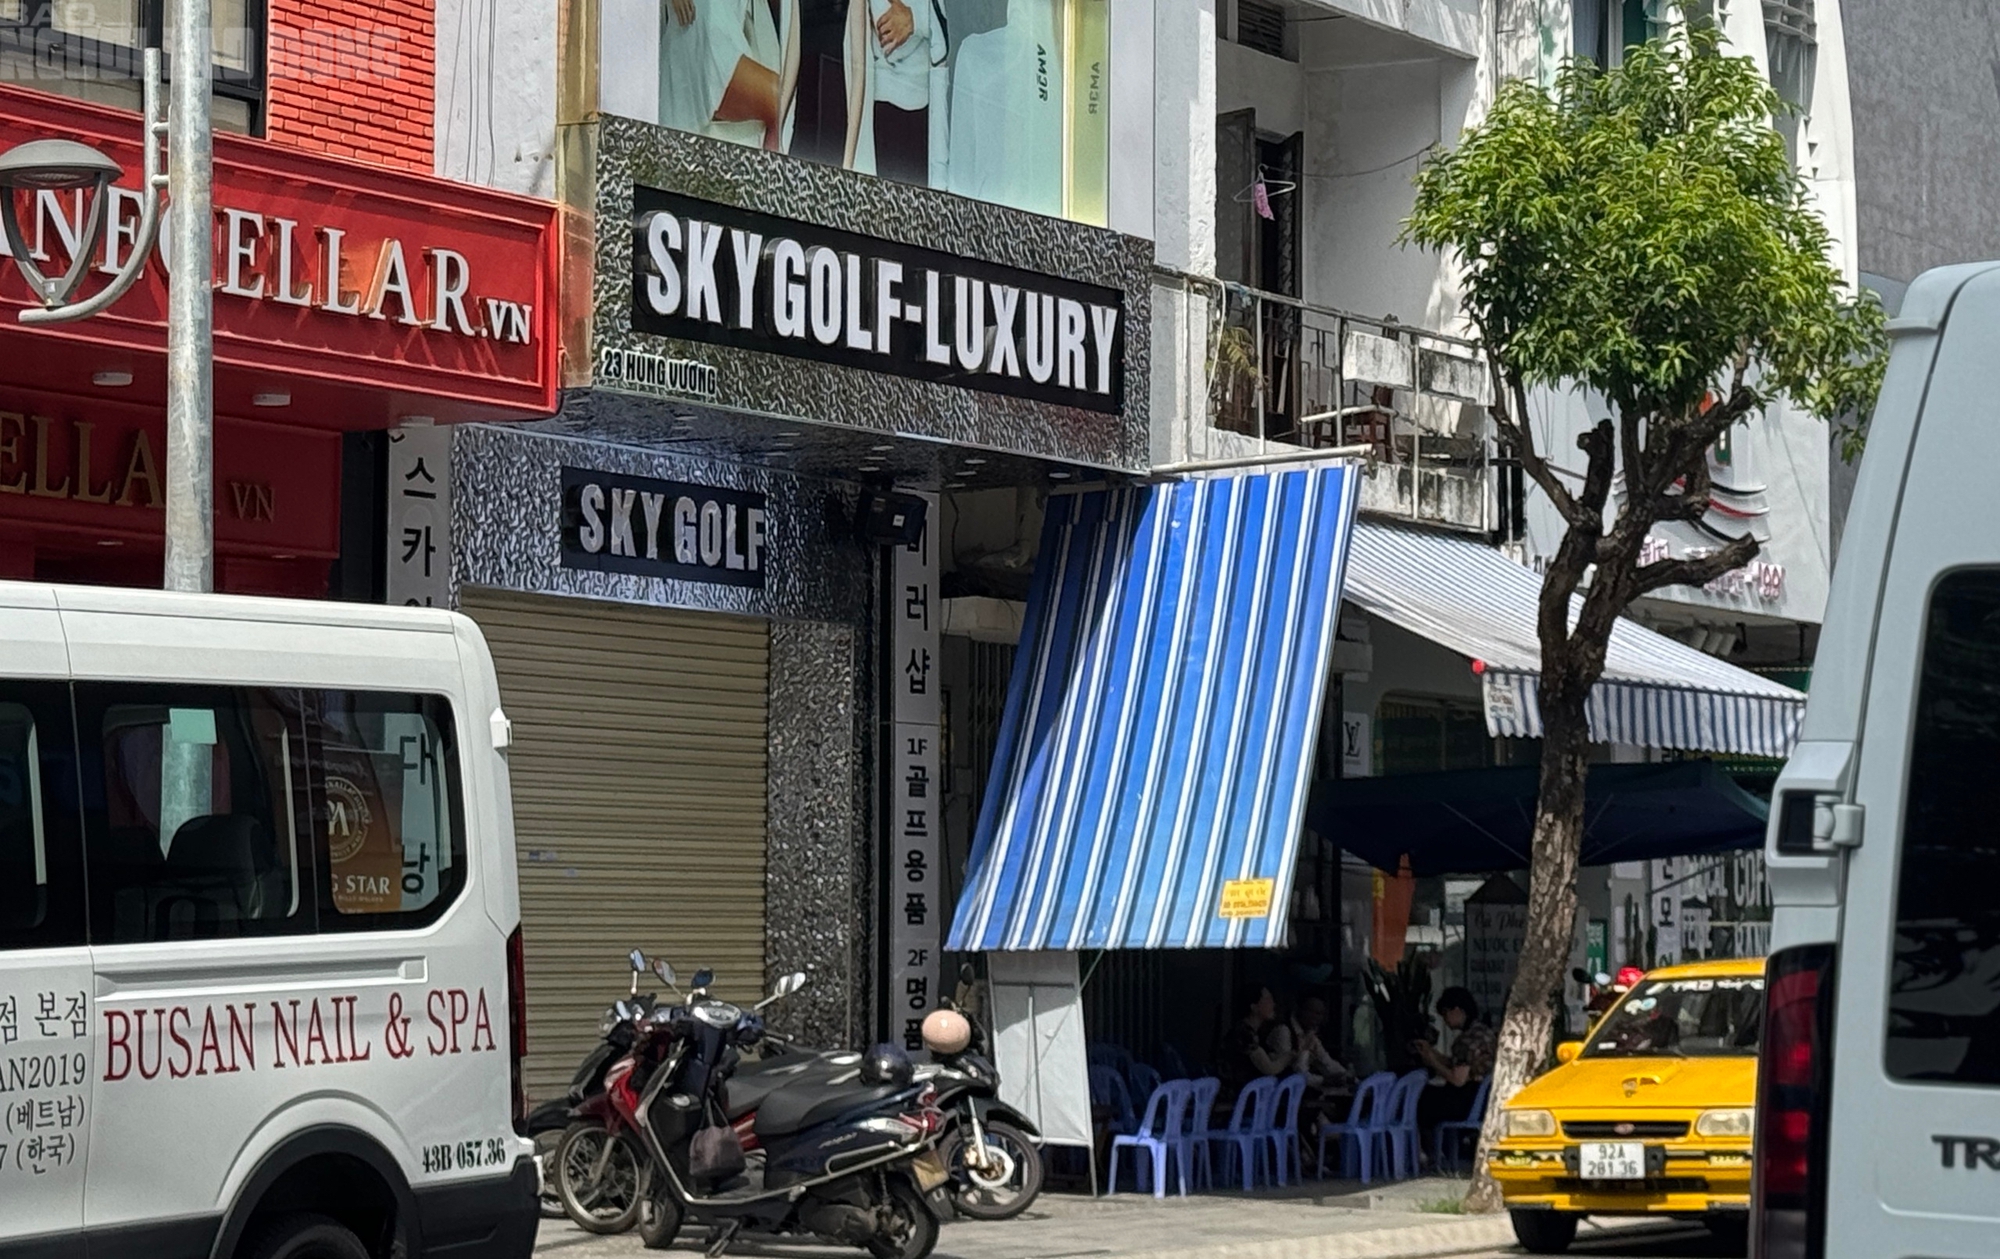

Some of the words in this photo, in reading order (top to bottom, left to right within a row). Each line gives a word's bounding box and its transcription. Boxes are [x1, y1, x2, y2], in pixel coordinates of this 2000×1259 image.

[603, 349, 623, 377] 23
[579, 484, 666, 561] SKY
[673, 495, 765, 572] GOLF
[346, 874, 391, 895] STAR
[907, 949, 929, 967] 2F
[34, 990, 88, 1040] 본점
[103, 1003, 257, 1083] BUSAN
[272, 996, 371, 1069] NAIL
[384, 992, 415, 1060] &
[426, 986, 497, 1057] SPA
[6, 1094, 85, 1135] (베트남)
[15, 1132, 76, 1175] (한국)
[1599, 1144, 1626, 1160] 92A
[1930, 1134, 2000, 1171] TR
